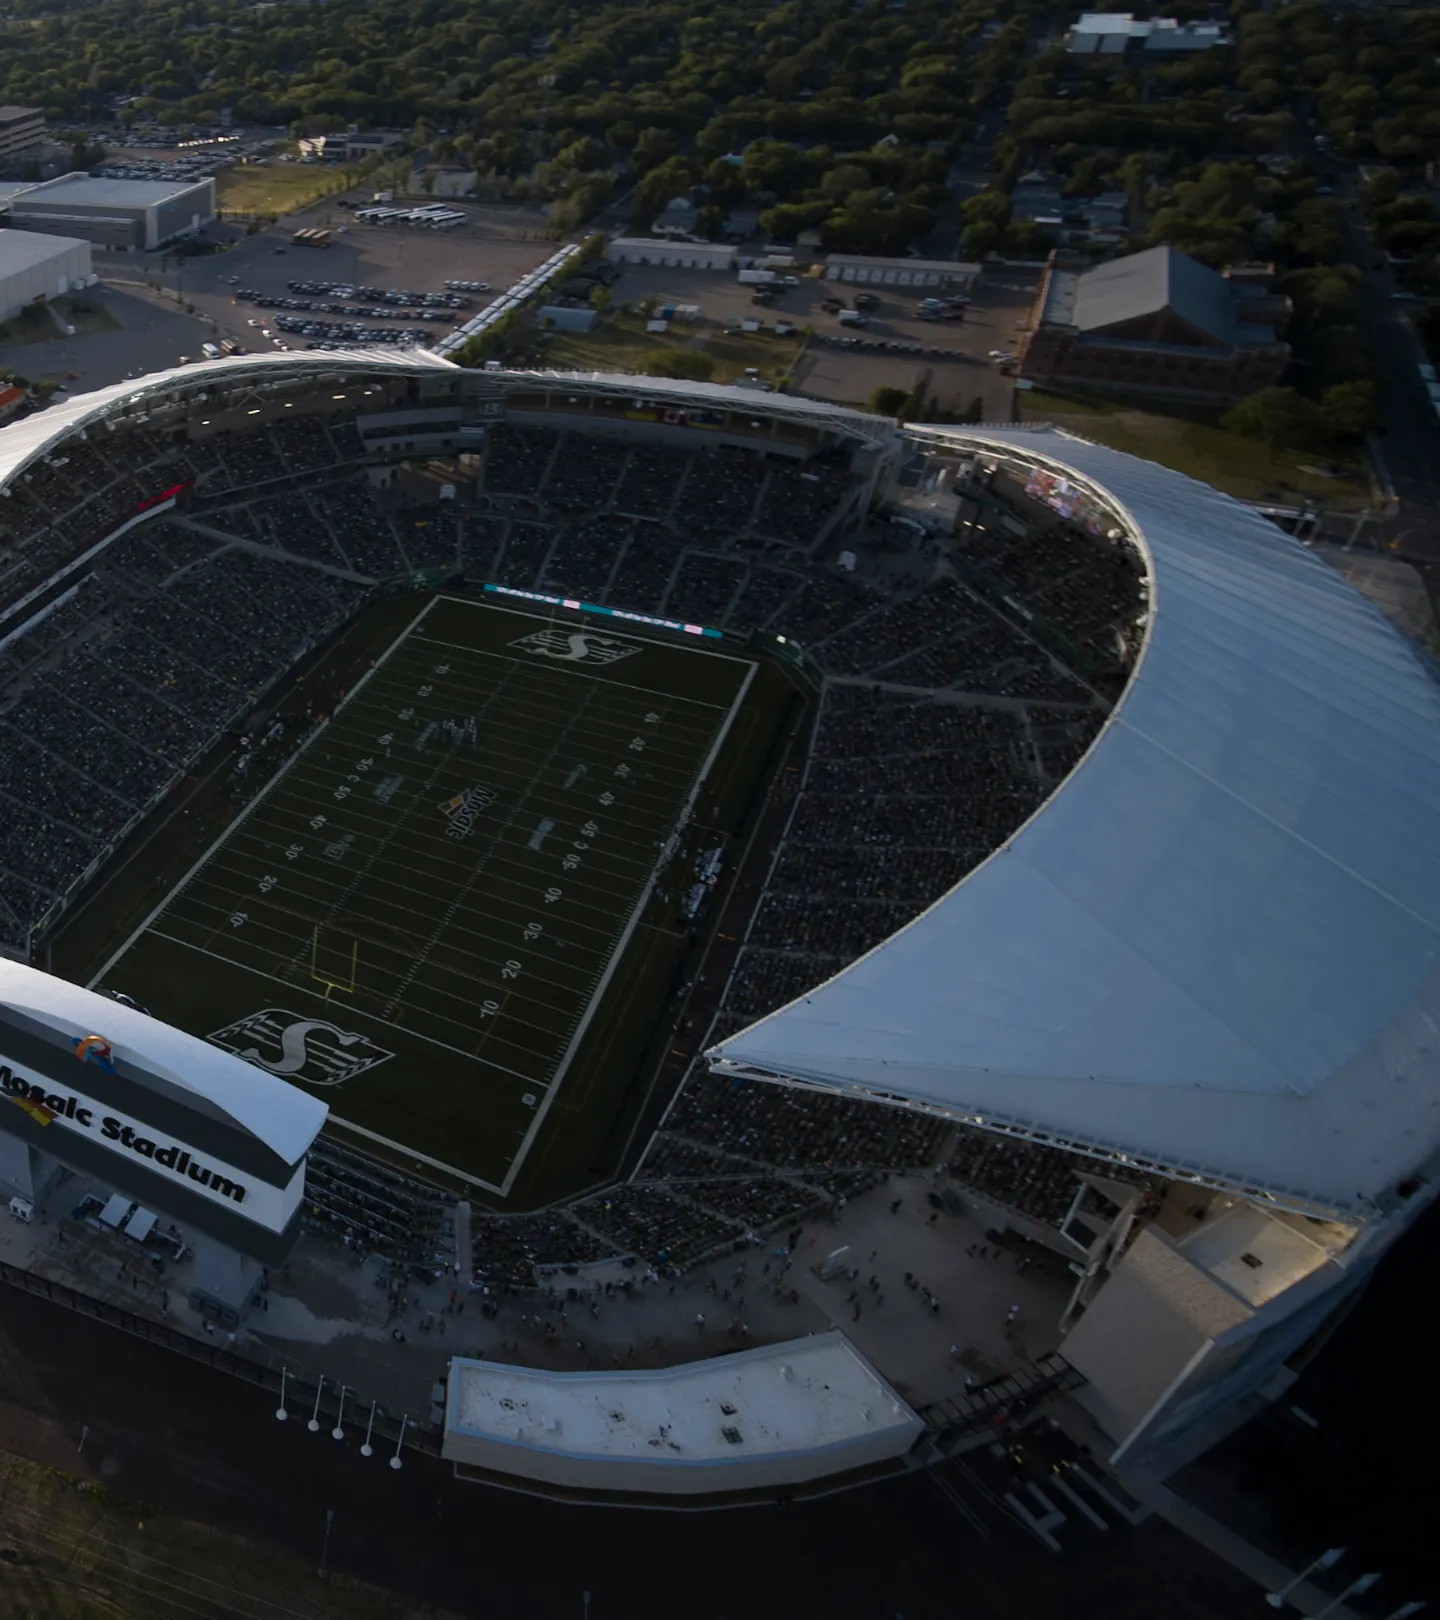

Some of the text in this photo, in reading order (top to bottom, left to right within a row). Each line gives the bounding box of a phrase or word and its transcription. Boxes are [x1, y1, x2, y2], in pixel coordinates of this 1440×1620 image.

[436, 664, 450, 675] 10
[417, 685, 433, 697] 20
[398, 708, 414, 720] 30
[377, 732, 394, 745] 40
[629, 737, 646, 751] 20
[356, 757, 374, 771] 50
[613, 763, 631, 778] 30
[333, 785, 352, 800] 50
[598, 791, 615, 806] 40
[445, 785, 498, 840] Mosaic
[310, 814, 327, 829] 40
[580, 821, 599, 837] 50
[285, 844, 304, 859] 30
[562, 854, 581, 870] 50
[258, 875, 278, 891] 20
[545, 887, 562, 903] 40
[230, 911, 249, 926] 10
[525, 922, 543, 940] 30
[502, 960, 522, 979] 20
[481, 1000, 499, 1017] 10
[100, 1116, 248, 1204] Stadium
